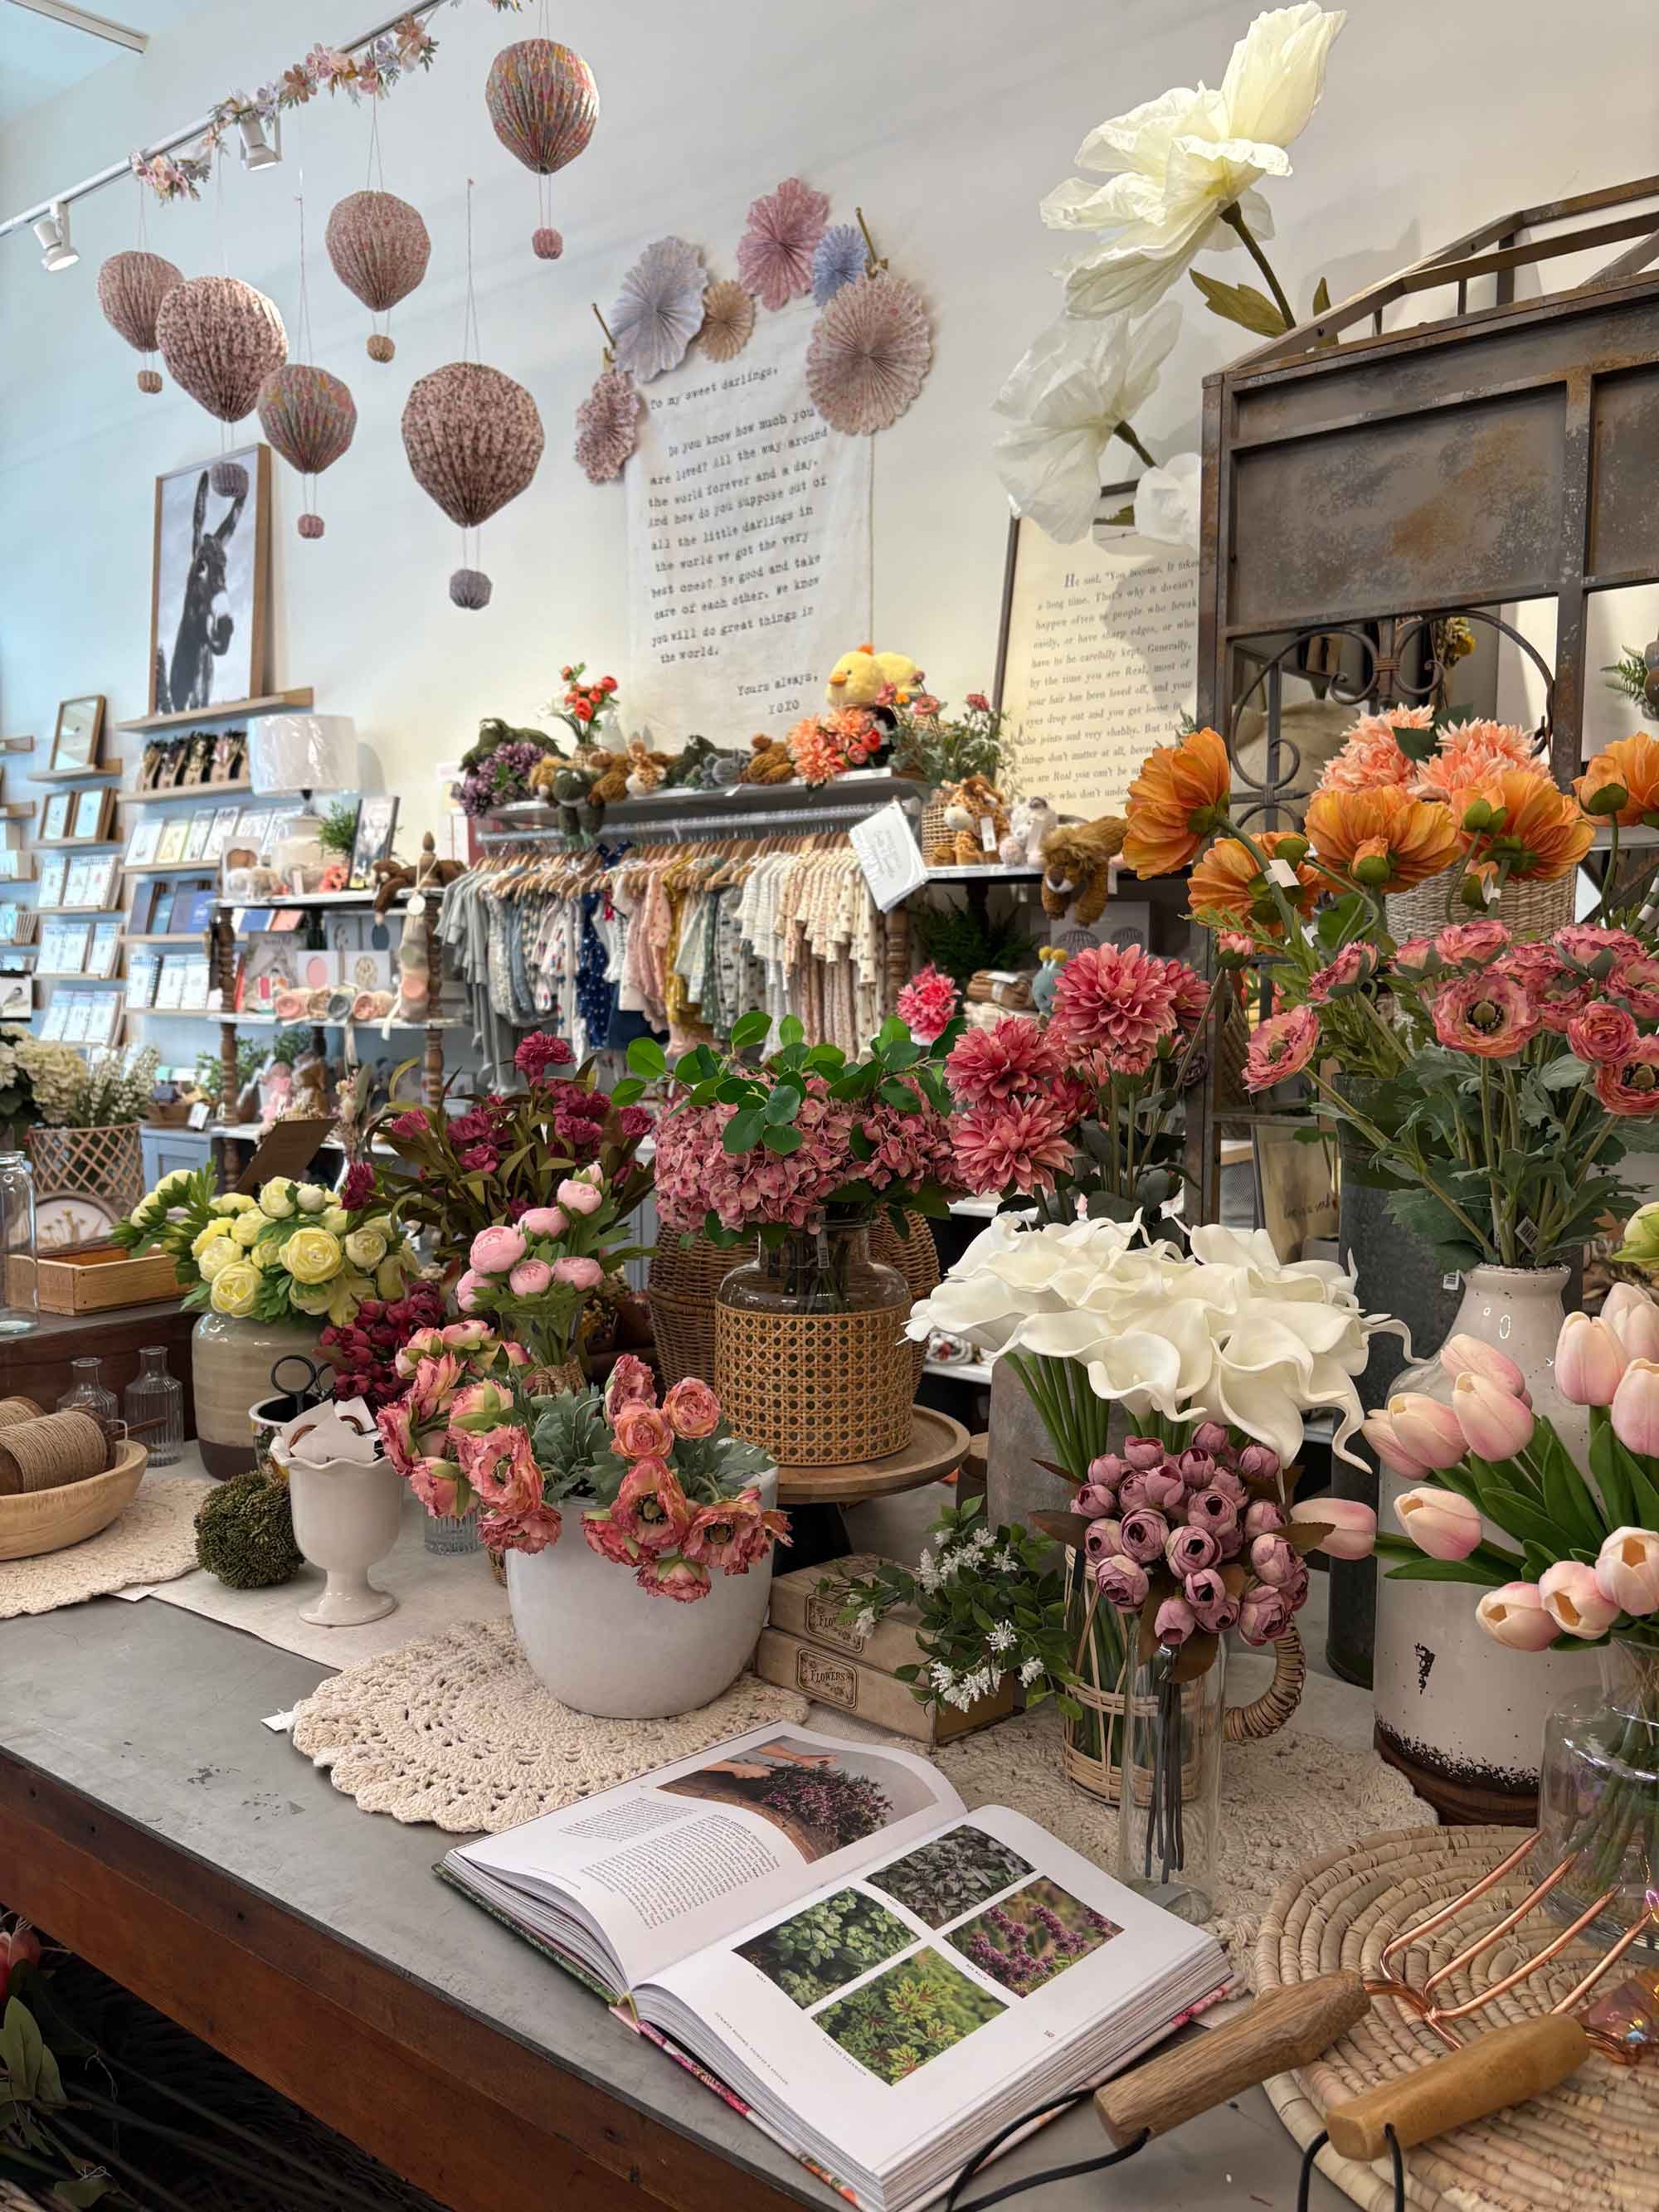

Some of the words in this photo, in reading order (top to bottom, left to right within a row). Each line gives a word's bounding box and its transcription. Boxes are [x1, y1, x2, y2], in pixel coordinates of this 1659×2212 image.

[650, 398, 663, 410] To
[667, 396, 681, 407] my
[685, 382, 717, 400] sweet
[722, 367, 779, 390] darlings,
[682, 439, 702, 455] you
[706, 432, 732, 445] know
[735, 424, 756, 438] how
[759, 413, 787, 430] much
[792, 406, 815, 424] you
[649, 474, 671, 485] are
[737, 447, 757, 461] the
[761, 439, 782, 455] way
[787, 425, 828, 448] around
[648, 497, 669, 508] the
[674, 490, 703, 504] world
[706, 475, 751, 495] forever
[756, 467, 776, 481] and
[781, 468, 790, 476] a
[674, 513, 694, 525] how
[698, 508, 710, 520] do
[713, 502, 733, 518] you
[737, 489, 784, 509] suppose
[789, 483, 806, 496] out
[813, 474, 828, 488] of
[651, 538, 671, 551] all
[678, 535, 697, 547] the
[703, 525, 739, 543] little
[742, 511, 794, 533] darlings
[799, 504, 814, 518] in
[654, 560, 674, 572] the
[679, 554, 713, 569] world
[718, 552, 731, 562] we
[735, 544, 754, 562] got
[759, 539, 776, 552] the
[781, 531, 810, 546] very
[650, 584, 674, 598] best
[679, 577, 713, 593] ones?
[738, 567, 764, 585] good
[768, 560, 789, 575] and
[794, 552, 821, 570] take
[1063, 572, 1080, 588] He
[654, 607, 677, 620] care
[681, 602, 696, 615] of
[701, 597, 728, 611] each
[794, 576, 820, 590] know
[1046, 600, 1064, 611] long
[1095, 588, 1124, 604] That's
[1126, 586, 1146, 599] why
[1149, 584, 1156, 594] it
[1160, 579, 1194, 593] doesn't
[651, 633, 669, 648] you
[670, 628, 697, 642] will
[702, 625, 716, 638] do
[720, 616, 755, 637] great
[758, 610, 798, 628] things
[800, 605, 814, 618] in
[1035, 618, 1068, 632] happen
[1070, 613, 1095, 624] often
[1112, 606, 1143, 624] people
[1147, 604, 1166, 614] who
[1170, 598, 1197, 611] break
[1078, 633, 1097, 644] have
[1102, 629, 1126, 641] sharp
[1162, 623, 1174, 632] or
[660, 653, 675, 664] the
[1031, 658, 1050, 669] have
[1053, 655, 1063, 665] to
[1066, 654, 1076, 664] be
[1080, 649, 1116, 664] carefully
[737, 683, 771, 697] Yours
[774, 673, 819, 689] always,
[1029, 678, 1042, 689] by
[1044, 675, 1058, 687] the
[1062, 673, 1081, 684] time
[1084, 672, 1102, 684] you
[1106, 668, 1121, 678] are
[1154, 663, 1176, 673] most
[1180, 659, 1191, 669] of
[1028, 697, 1047, 710] your
[1049, 693, 1065, 706] hair
[1068, 692, 1083, 702] has
[1086, 688, 1106, 701] been
[1109, 685, 1131, 697] loved
[1153, 684, 1169, 695] and
[1172, 680, 1192, 695] your
[1047, 712, 1068, 726] drop
[1070, 710, 1085, 721] out
[1088, 708, 1104, 720] and
[1107, 707, 1125, 721] you
[1127, 705, 1141, 718] get
[1040, 732, 1063, 745] joints
[1065, 730, 1081, 741] and
[1085, 727, 1105, 741] very
[1145, 722, 1160, 733] But
[1021, 752, 1044, 765] things
[1048, 751, 1068, 762] don't
[1071, 750, 1098, 761] matter
[1101, 748, 1110, 758] at
[1038, 772, 1051, 782] are
[1053, 770, 1073, 781] Real
[1075, 770, 1091, 782] you
[1093, 767, 1114, 778] can't
[1117, 766, 1129, 776] be
[1058, 789, 1078, 800] who
[1079, 786, 1102, 800] don't
[810, 1669, 845, 1684] FLOWERS
